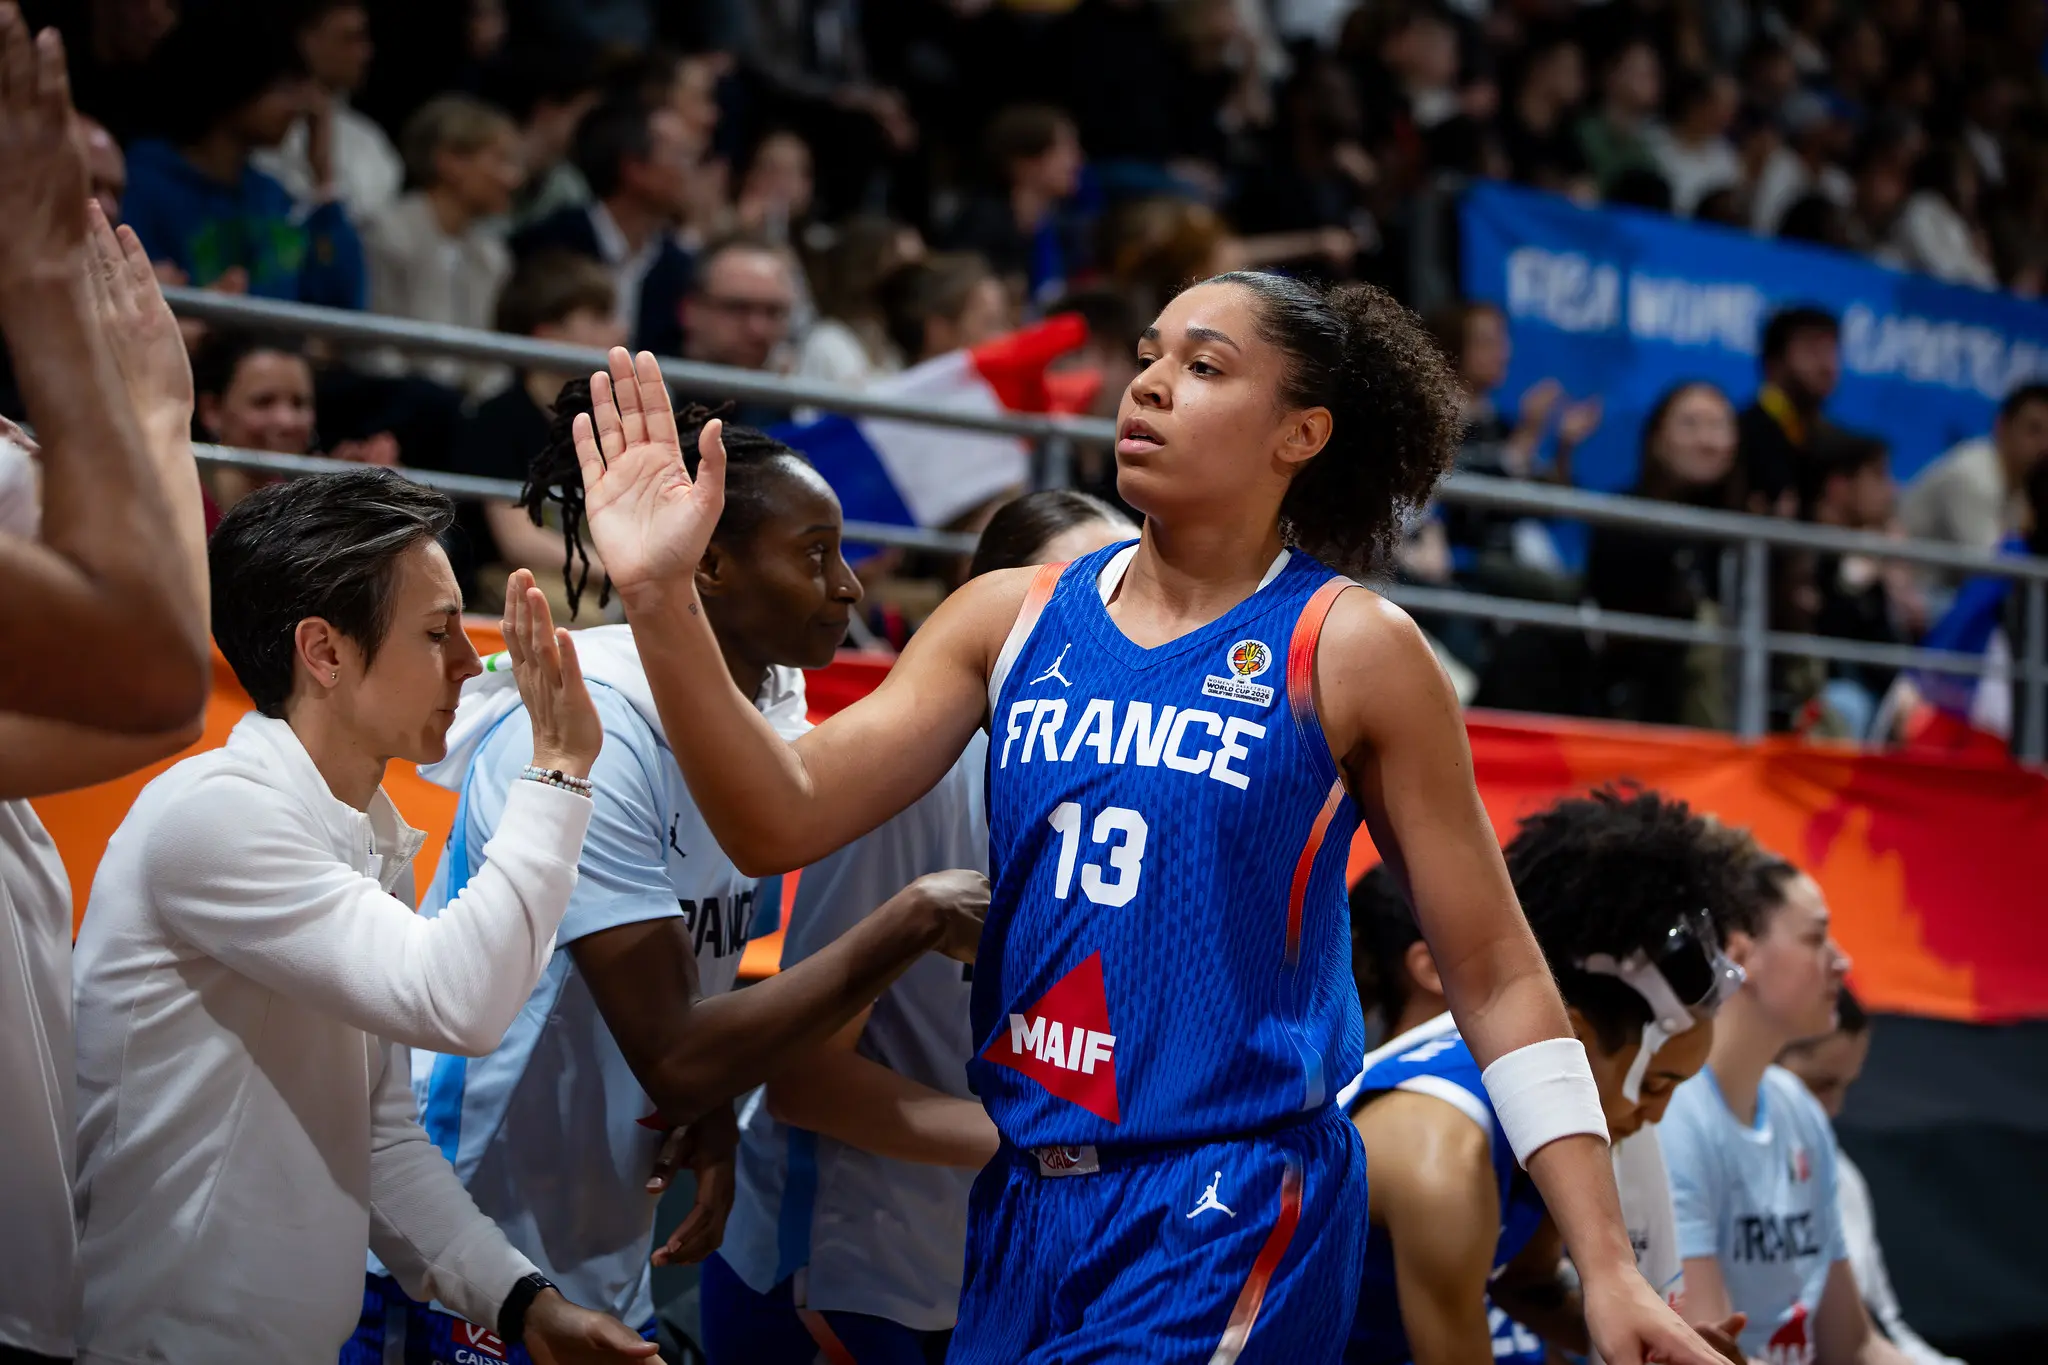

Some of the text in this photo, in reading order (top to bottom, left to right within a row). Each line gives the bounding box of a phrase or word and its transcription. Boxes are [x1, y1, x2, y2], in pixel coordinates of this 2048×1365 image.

[1207, 682, 1234, 692] WORLD
[1251, 691, 1270, 700] 2026
[1208, 689, 1265, 703] QUALIFYING TOURNAMENTS
[1000, 698, 1267, 791] FRANCE
[1047, 801, 1149, 908] 13
[1008, 1013, 1117, 1075] MAIF
